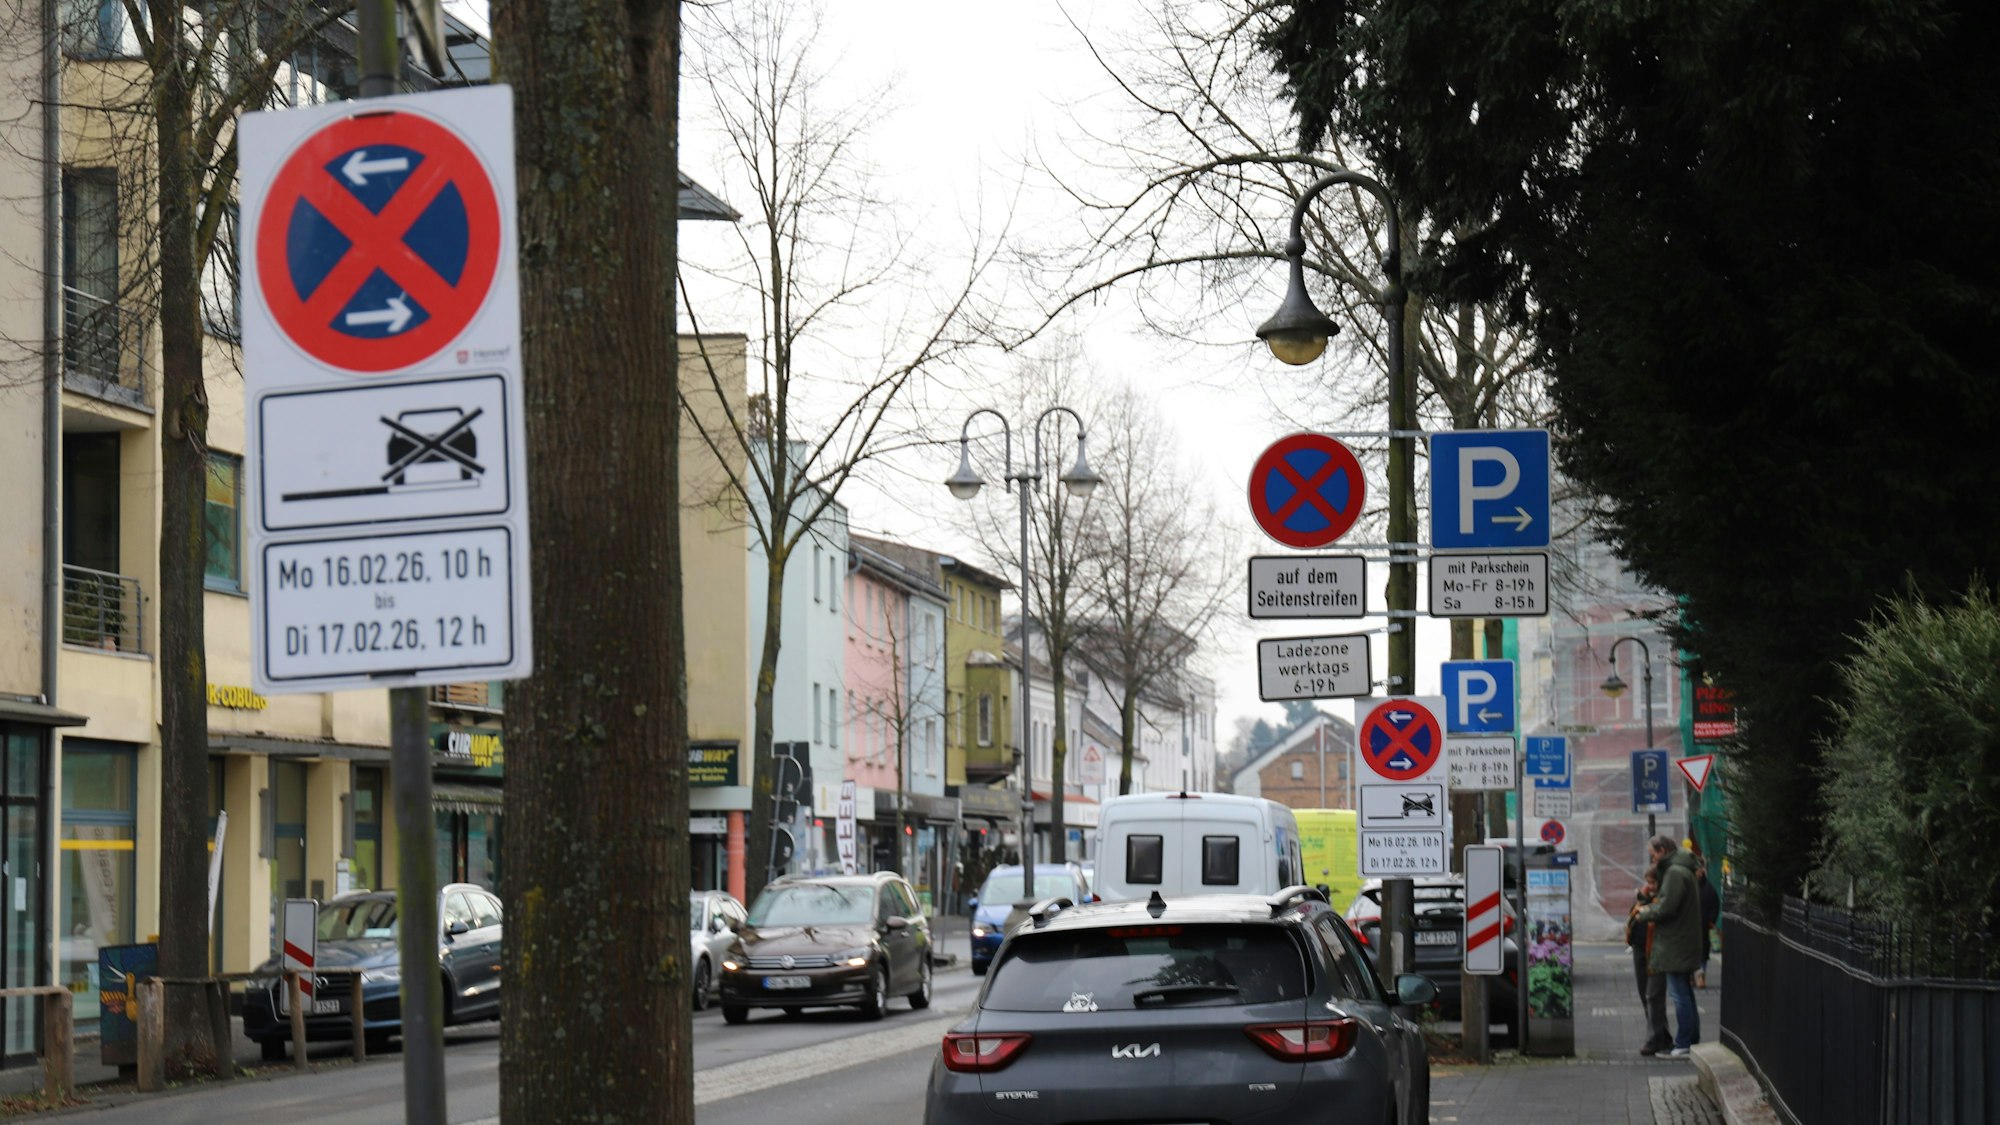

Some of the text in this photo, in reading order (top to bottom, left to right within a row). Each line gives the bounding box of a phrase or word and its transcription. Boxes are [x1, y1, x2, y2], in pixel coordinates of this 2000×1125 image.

[1459, 446, 1520, 534] P
[279, 558, 313, 590] Mo
[442, 548, 468, 580] 10
[478, 547, 491, 578] h
[1448, 560, 1530, 574] mit Parkschein
[1277, 567, 1338, 584] auf dem
[1443, 579, 1488, 592] Mo-Fr
[375, 592, 395, 609] bis
[1257, 590, 1357, 607] Seitenstreifen
[1443, 597, 1462, 610] Sa
[286, 625, 308, 656] Di
[436, 616, 463, 647] 12
[472, 614, 486, 645] h
[1277, 643, 1349, 658] Ladezone
[1278, 660, 1350, 677] werktags
[1458, 670, 1497, 725] P
[1449, 746, 1511, 757] mit Parkschein
[1644, 758, 1657, 777] P
[1451, 776, 1461, 786] Sa
[1368, 837, 1381, 847] Mo
[1422, 836, 1432, 847] 10
[1434, 836, 1439, 847] h
[1370, 857, 1379, 868] Di
[1421, 857, 1430, 868] 12
[1432, 857, 1438, 868] h
[1112, 1043, 1161, 1059] KIA
